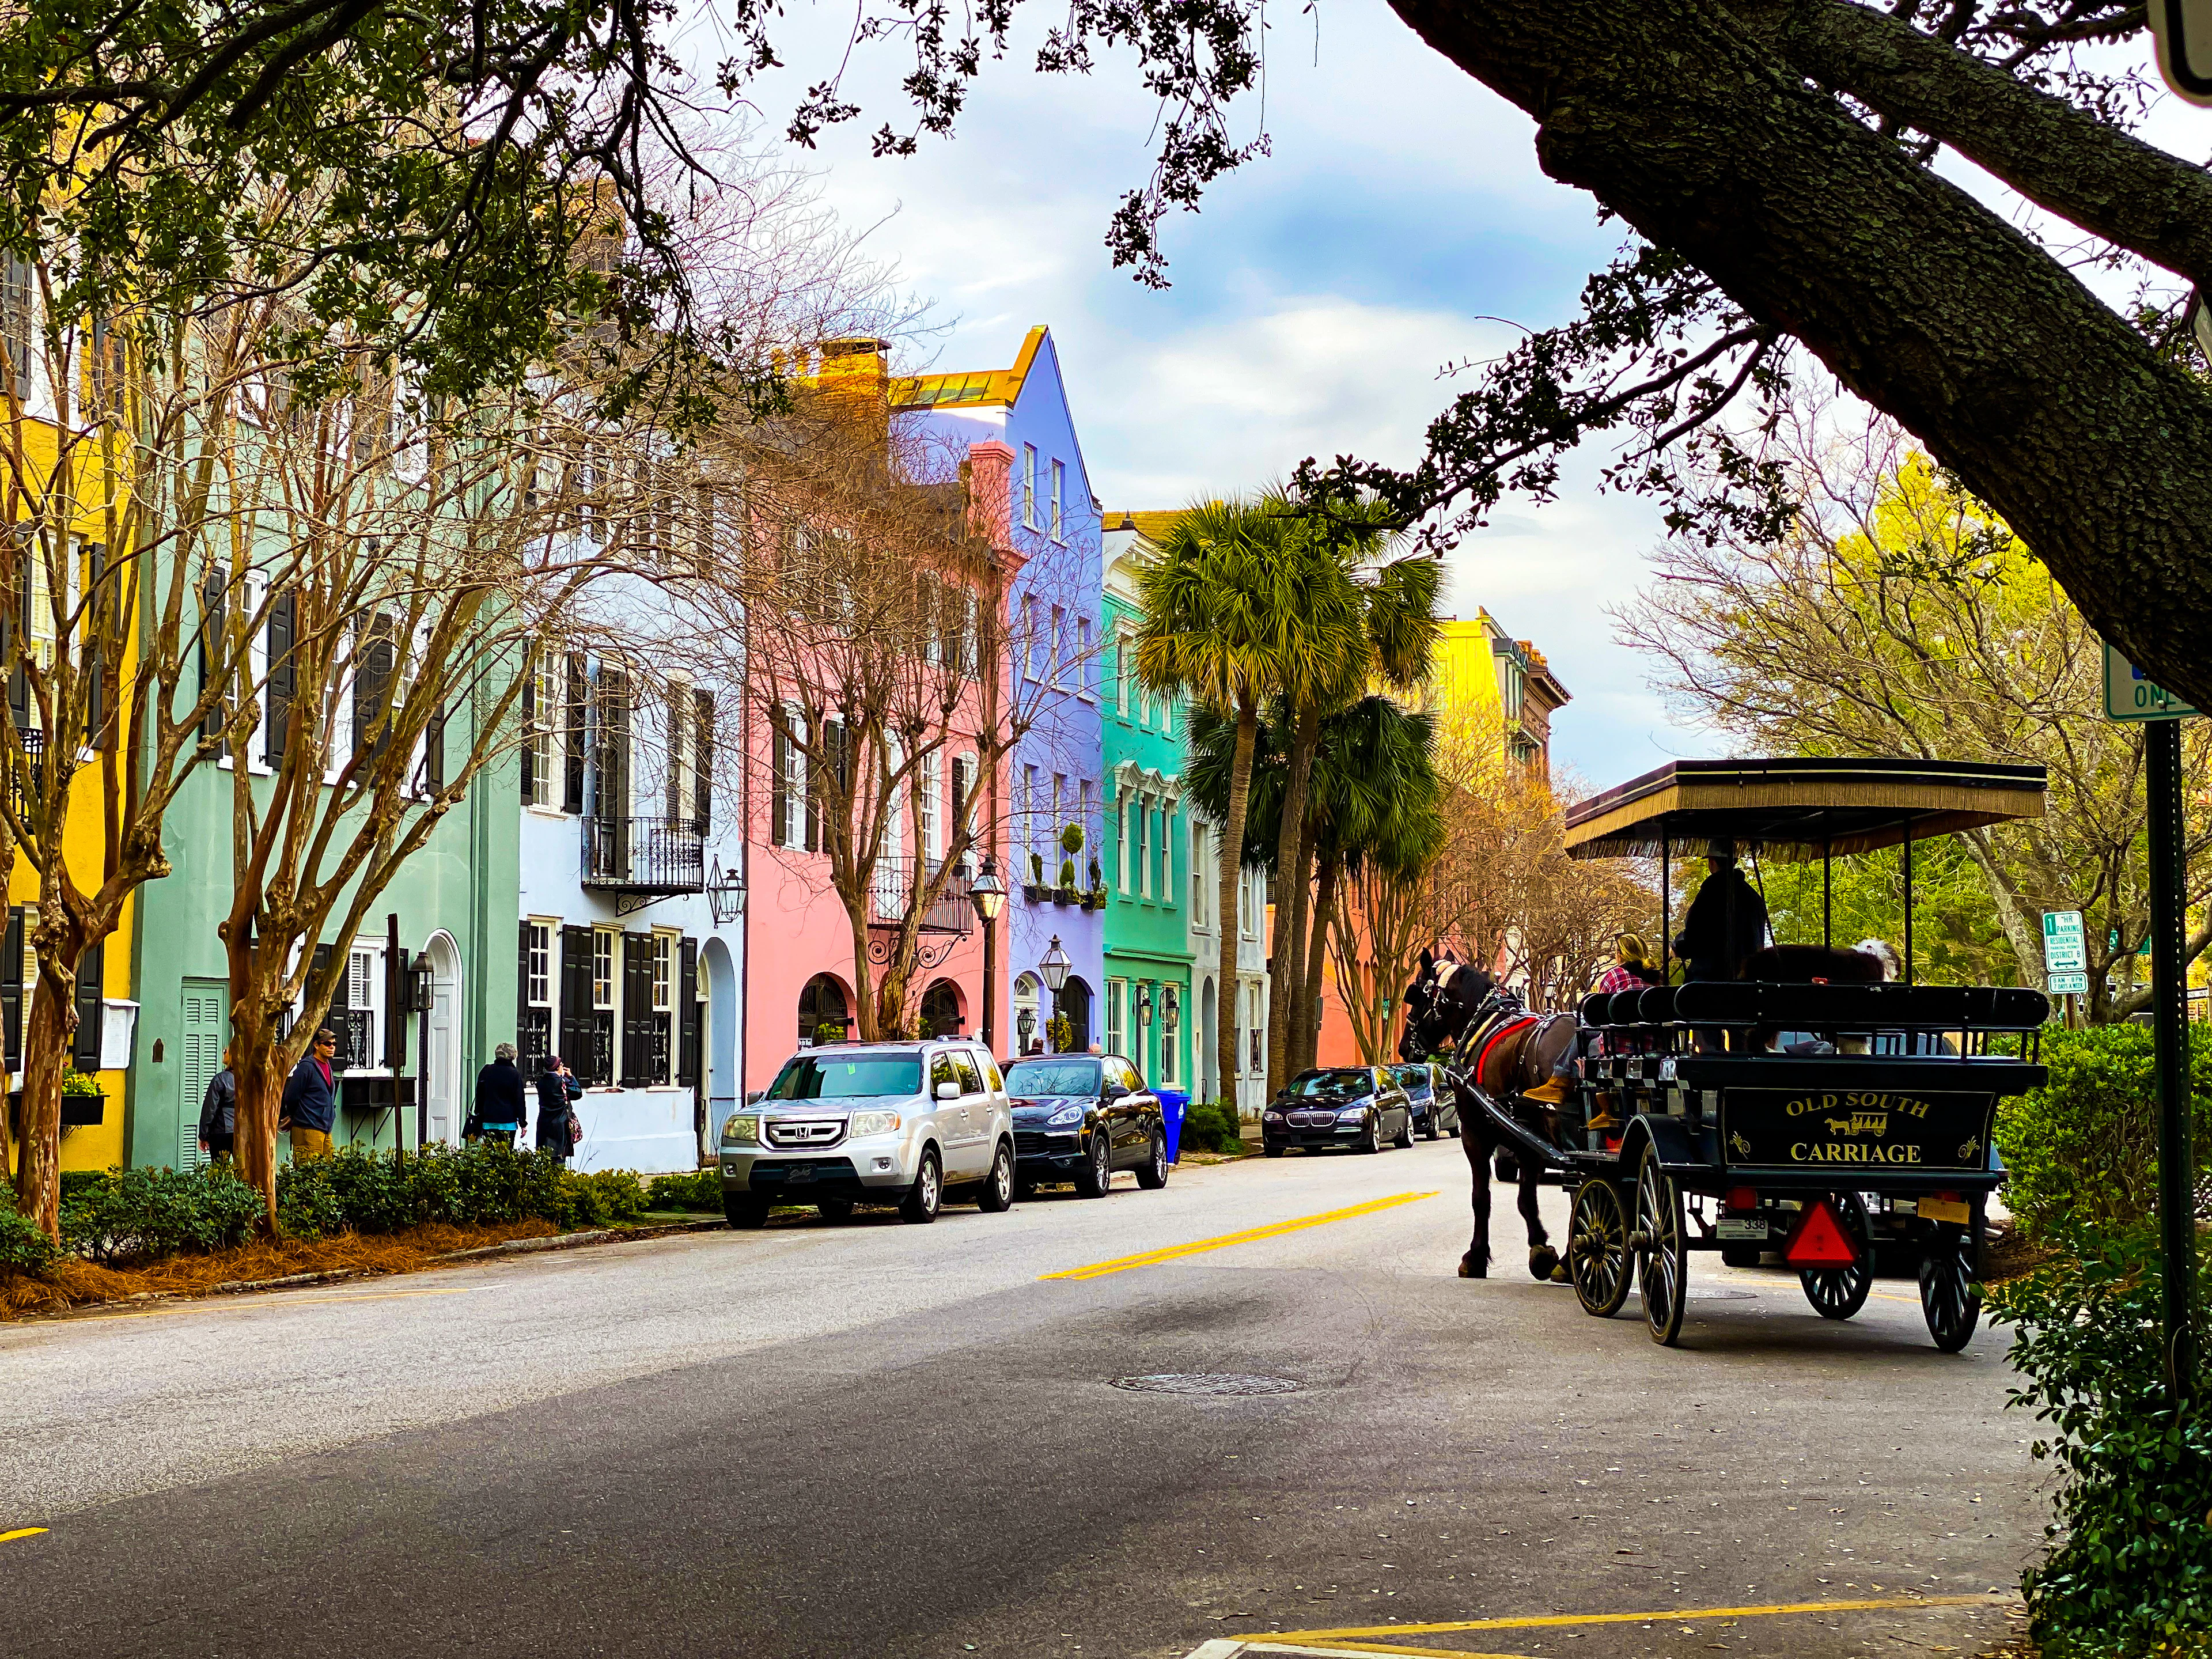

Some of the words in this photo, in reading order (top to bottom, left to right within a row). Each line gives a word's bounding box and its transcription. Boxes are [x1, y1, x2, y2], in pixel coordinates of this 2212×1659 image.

[2135, 684, 2186, 707] ONL
[2047, 918, 2053, 933] 1
[2056, 925, 2080, 933] PARKING
[2050, 935, 2079, 945] RESIDENTIAL
[2051, 951, 2073, 959] DISTRICT
[1786, 1094, 1838, 1116] OLD
[1846, 1093, 1930, 1118] SOUTH
[1790, 1143, 1921, 1163] CARRIAGE
[1744, 1219, 1766, 1229] 338
